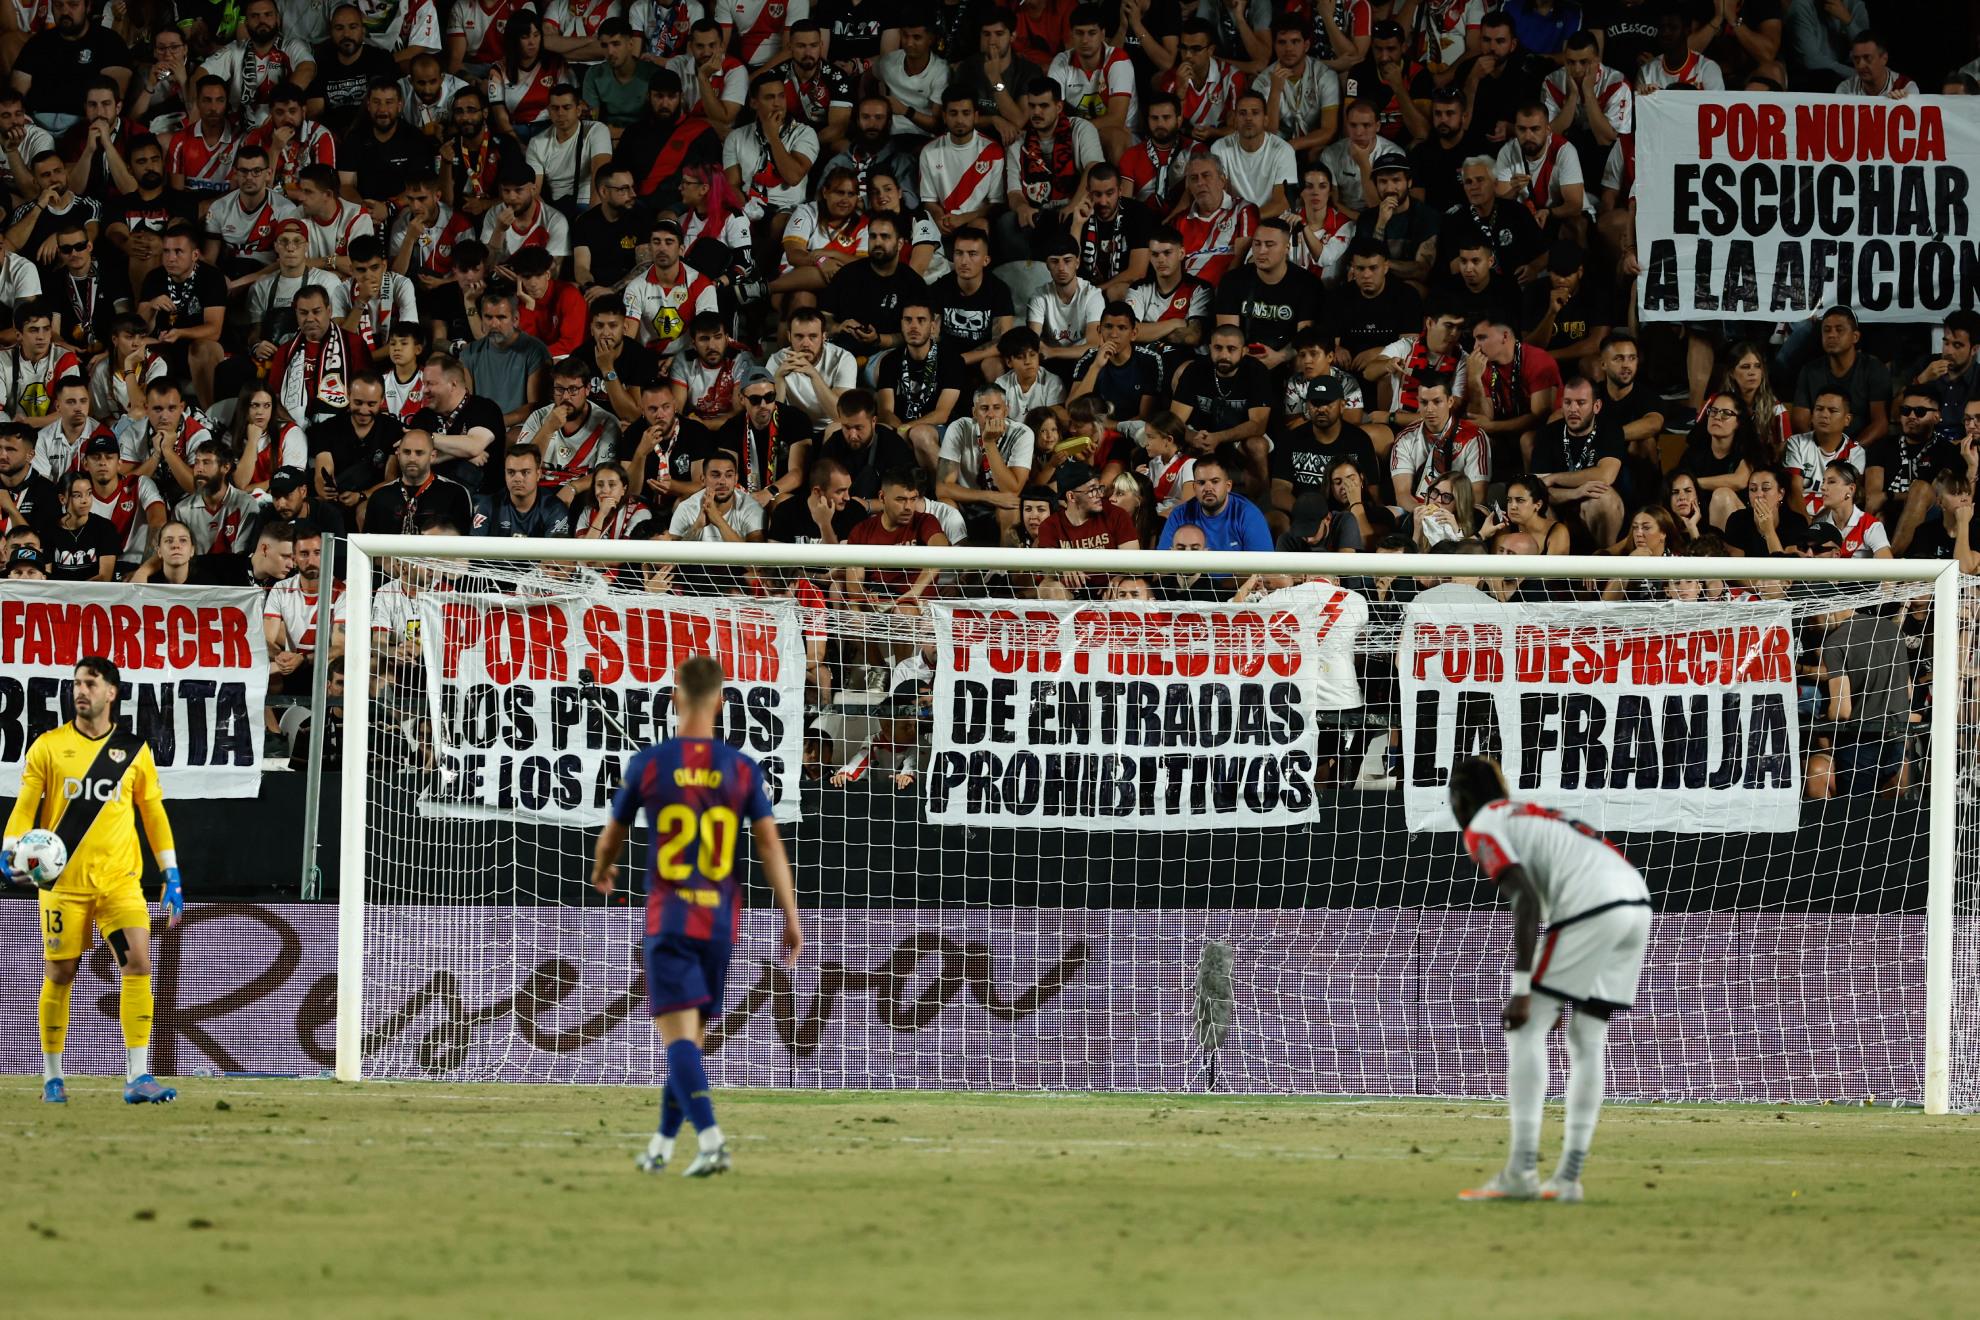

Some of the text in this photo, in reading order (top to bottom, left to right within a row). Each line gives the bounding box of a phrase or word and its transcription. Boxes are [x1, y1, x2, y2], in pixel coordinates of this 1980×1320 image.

[1698, 103, 1947, 164] POR NUNCA
[1673, 163, 1969, 237] ESCUCHAR
[1644, 239, 1680, 311] A
[1694, 238, 1759, 312] LA
[2, 600, 252, 670] FAVORECER
[442, 603, 779, 685] POR SUBIR
[952, 609, 1302, 678] POR PRECIOS
[1412, 622, 1792, 686] POR DESPRECIAR
[441, 684, 538, 751] LOS
[951, 678, 1304, 748] DE ENTRADAS
[1412, 690, 1792, 790] LA FRANJA
[63, 777, 122, 802] DIGI
[497, 754, 583, 811] LOS
[929, 750, 1313, 818] PROHIBITIVOS
[656, 803, 738, 882] 20
[45, 909, 63, 934] 13
